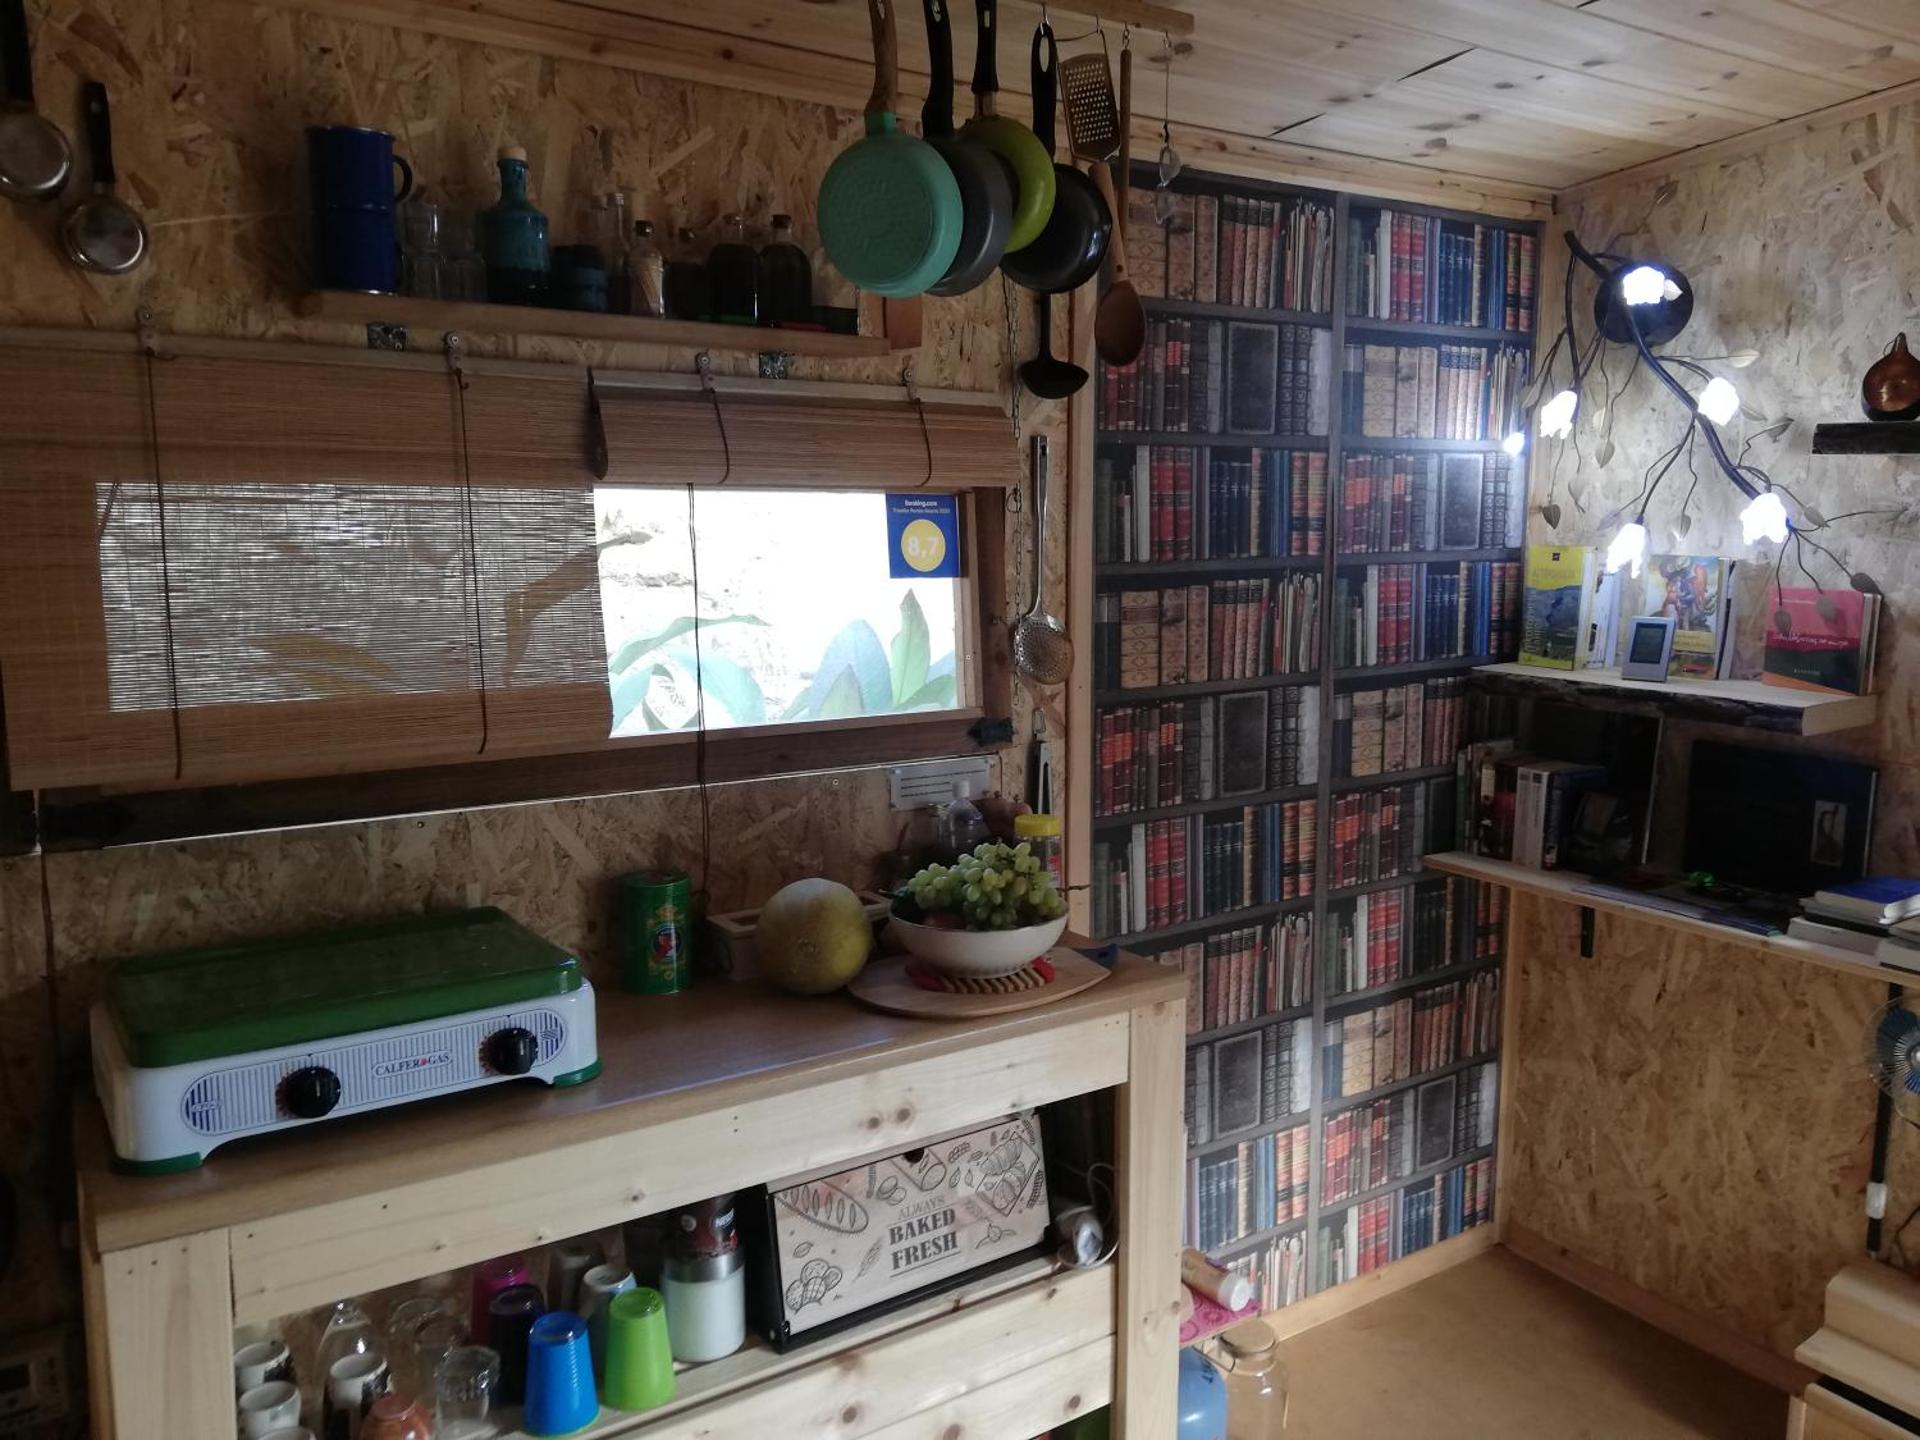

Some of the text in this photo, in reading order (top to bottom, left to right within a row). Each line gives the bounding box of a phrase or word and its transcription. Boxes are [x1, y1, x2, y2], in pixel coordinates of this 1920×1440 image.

[375, 1055, 450, 1076] CALFER GAS
[889, 1208, 955, 1245] BAKED
[891, 1231, 958, 1270] FRESH
